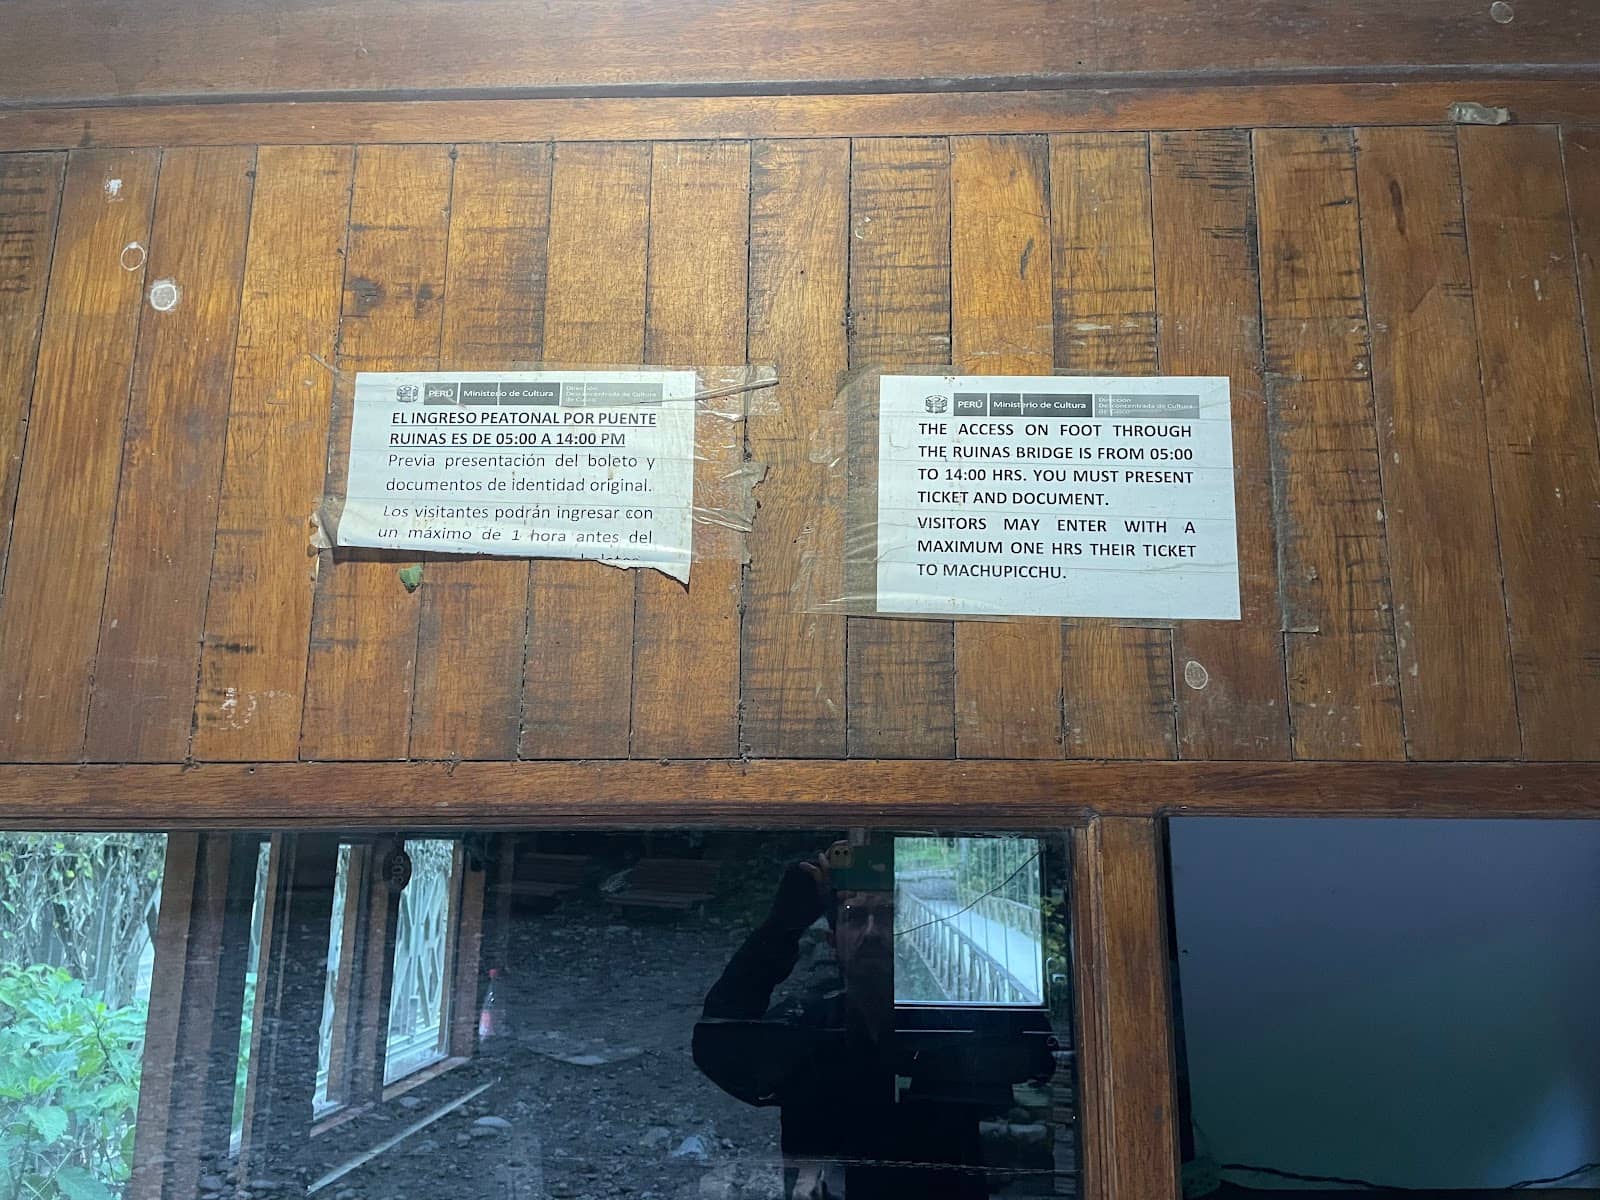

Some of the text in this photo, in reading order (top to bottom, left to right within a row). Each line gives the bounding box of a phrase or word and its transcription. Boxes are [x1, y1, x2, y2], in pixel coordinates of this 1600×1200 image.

[509, 389, 520, 397] de
[522, 389, 554, 397] Cultura
[958, 400, 983, 409] PERÚ
[1039, 401, 1052, 410] de
[1053, 401, 1086, 410] Cultura
[392, 412, 657, 425] EL INGRESO PEATONAL POR PUENTE
[389, 432, 625, 445] RUINAS ES DE 05:00 A 14:00 PM
[919, 423, 1192, 438] THE ACCESS ON FOOT THROUGH
[919, 445, 1193, 461] THE RUINAS BRIDGE IS FROM 05:00
[388, 453, 655, 472] Previa presentación del boleto y
[918, 468, 1194, 484] TO 14:00 HRS. YOU MUST PRESENT
[386, 477, 652, 496] documentos de identidad original.
[918, 491, 1109, 506] TICKET AND DOCUMENT.
[383, 503, 653, 523] Los visitantes podrán ingresar con
[917, 516, 1195, 534] VISITORS MAY ENTER WITH A
[378, 527, 653, 545] un máximo de 1 hora antes del
[917, 540, 1197, 558] MAXIMUM ONE HRS THEIR TICKET
[918, 563, 1067, 579] TO MACHUPICCHU.
